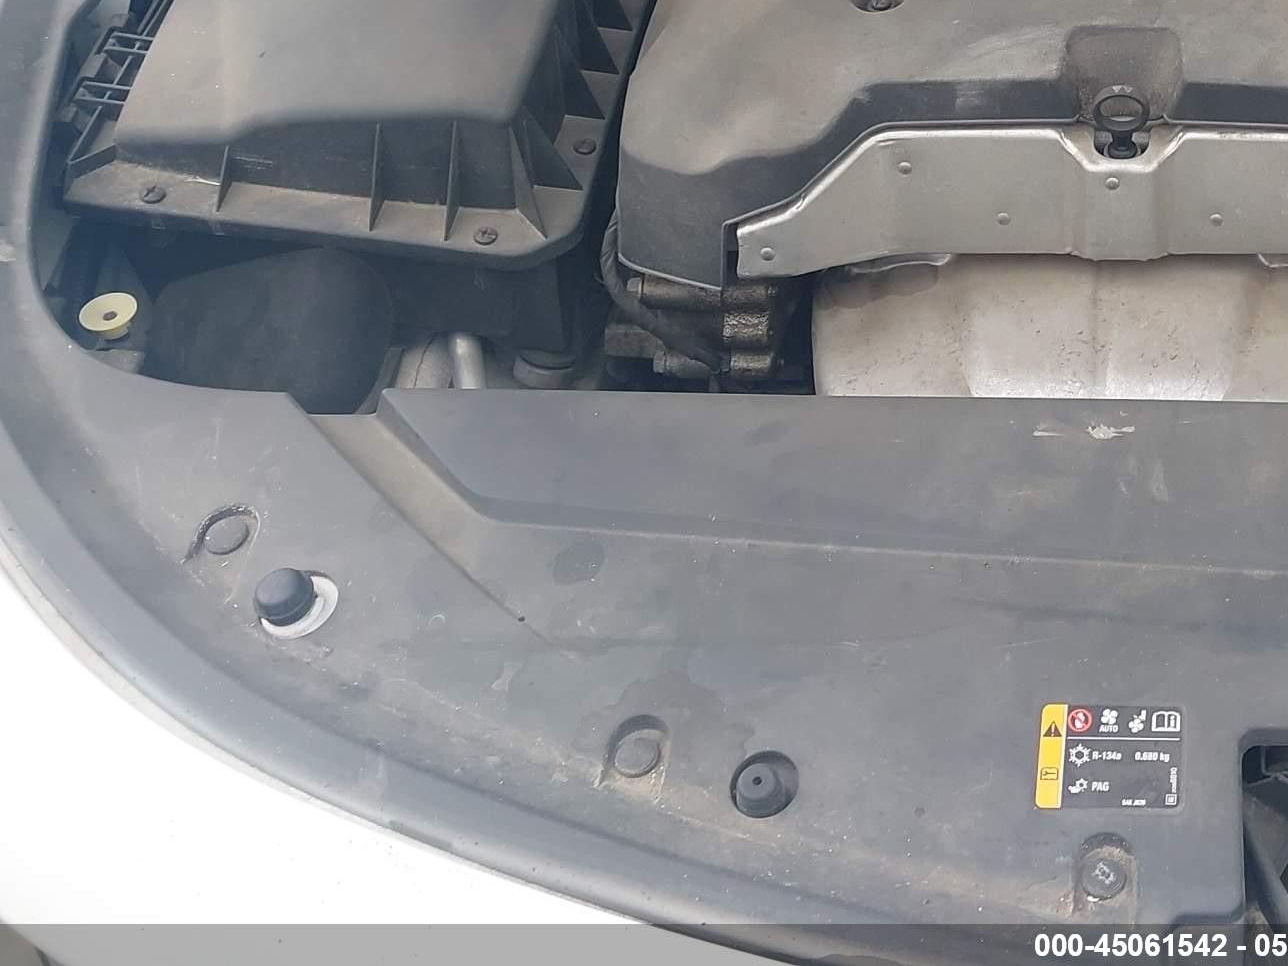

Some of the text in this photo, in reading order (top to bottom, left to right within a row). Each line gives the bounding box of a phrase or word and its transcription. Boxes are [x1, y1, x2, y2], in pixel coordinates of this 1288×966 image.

[1099, 724, 1119, 733] AUTO
[1092, 750, 1122, 761] R-134a
[1159, 751, 1170, 763] kg
[1091, 781, 1110, 792] PAG
